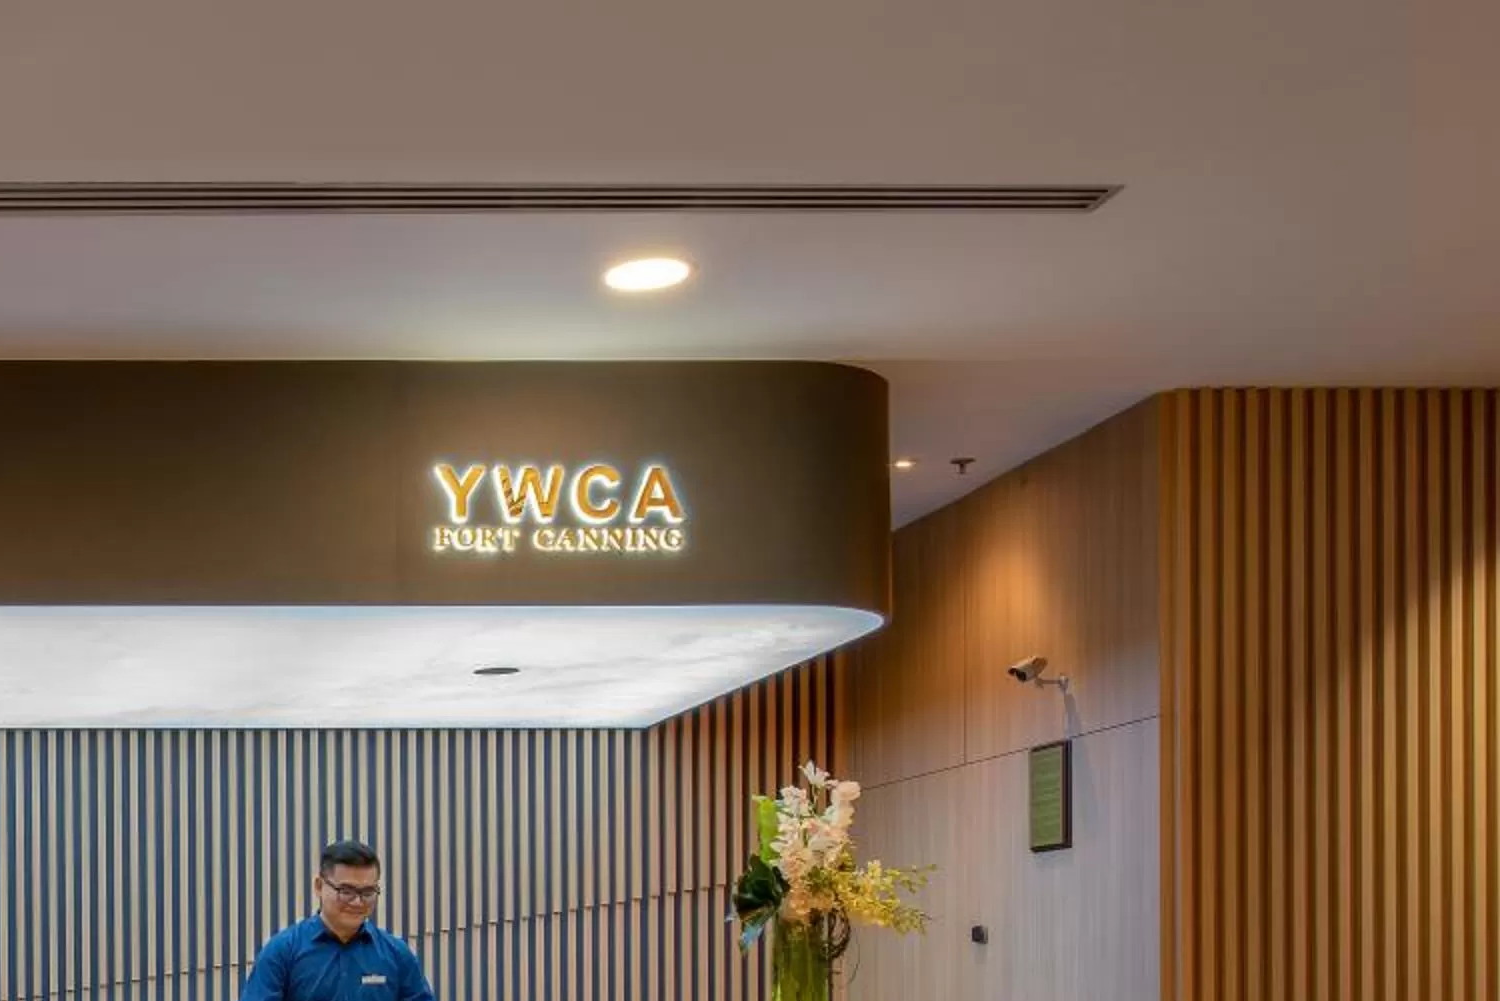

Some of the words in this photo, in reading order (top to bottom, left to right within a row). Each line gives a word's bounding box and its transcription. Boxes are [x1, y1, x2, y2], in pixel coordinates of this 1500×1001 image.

[434, 463, 684, 523] YWCA
[433, 527, 519, 551] FORT
[532, 527, 685, 551] CANNING
